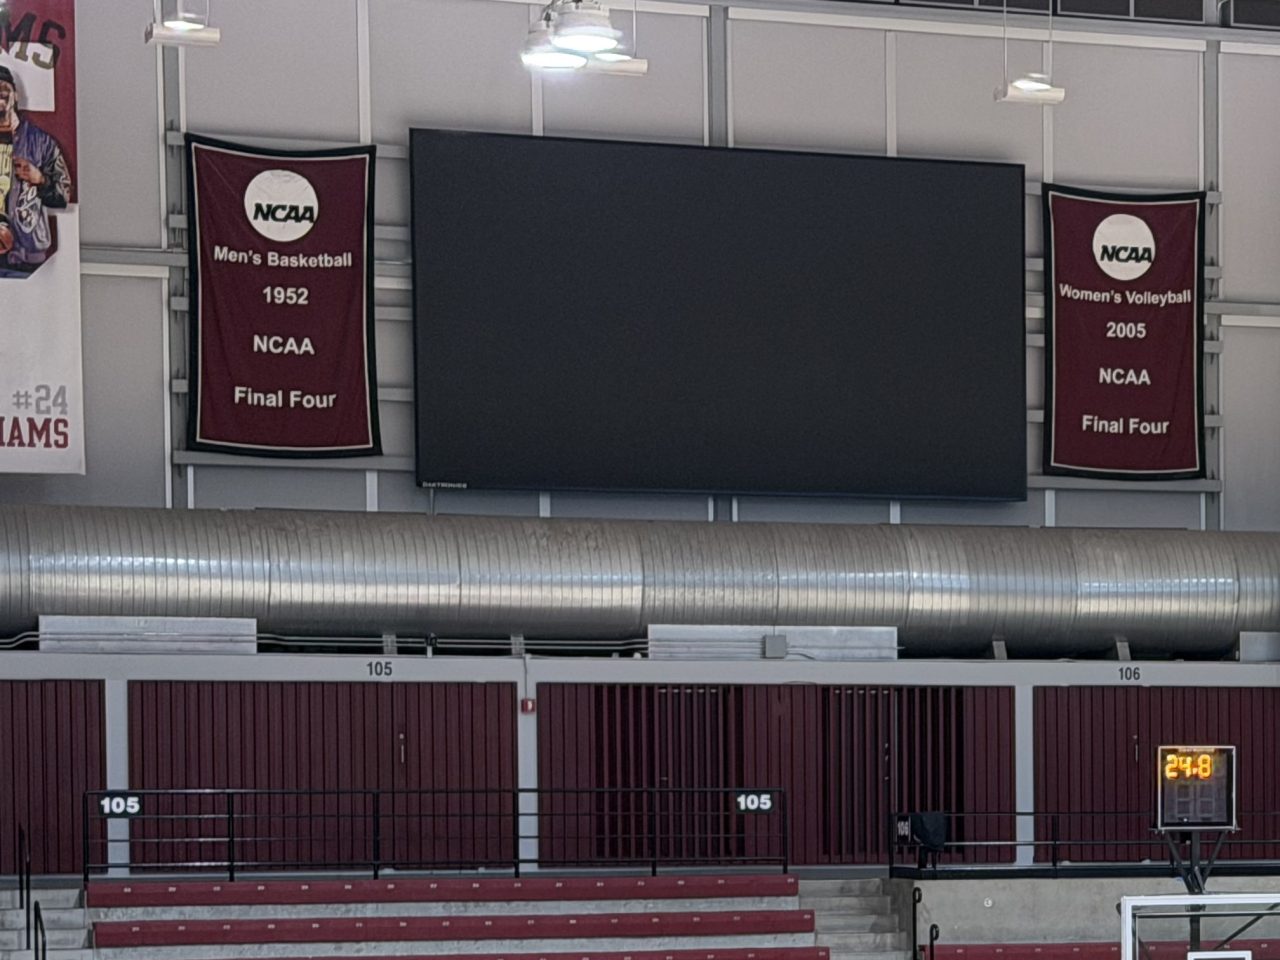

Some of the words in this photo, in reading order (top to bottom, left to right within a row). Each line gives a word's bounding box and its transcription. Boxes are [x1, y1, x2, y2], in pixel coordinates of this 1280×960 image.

[253, 203, 315, 223] NCAA
[213, 245, 262, 265] Men's
[267, 251, 352, 268] Basketball
[1100, 244, 1153, 263] NCAA
[262, 286, 309, 304] 1952
[1059, 283, 1122, 304] Women's
[1125, 289, 1192, 307] Volleyball
[1106, 321, 1147, 338] 2005
[253, 335, 315, 355] NCAA
[1099, 367, 1151, 385] NCAA
[12, 384, 68, 415] #24
[234, 386, 283, 407] Final
[290, 390, 337, 408] Four
[1082, 415, 1124, 434] Final
[1129, 418, 1170, 434] Four
[366, 661, 392, 676] 105
[1118, 666, 1140, 681] 106
[1165, 754, 1211, 779] 24.8
[100, 796, 140, 814] 105
[737, 794, 772, 810] 105
